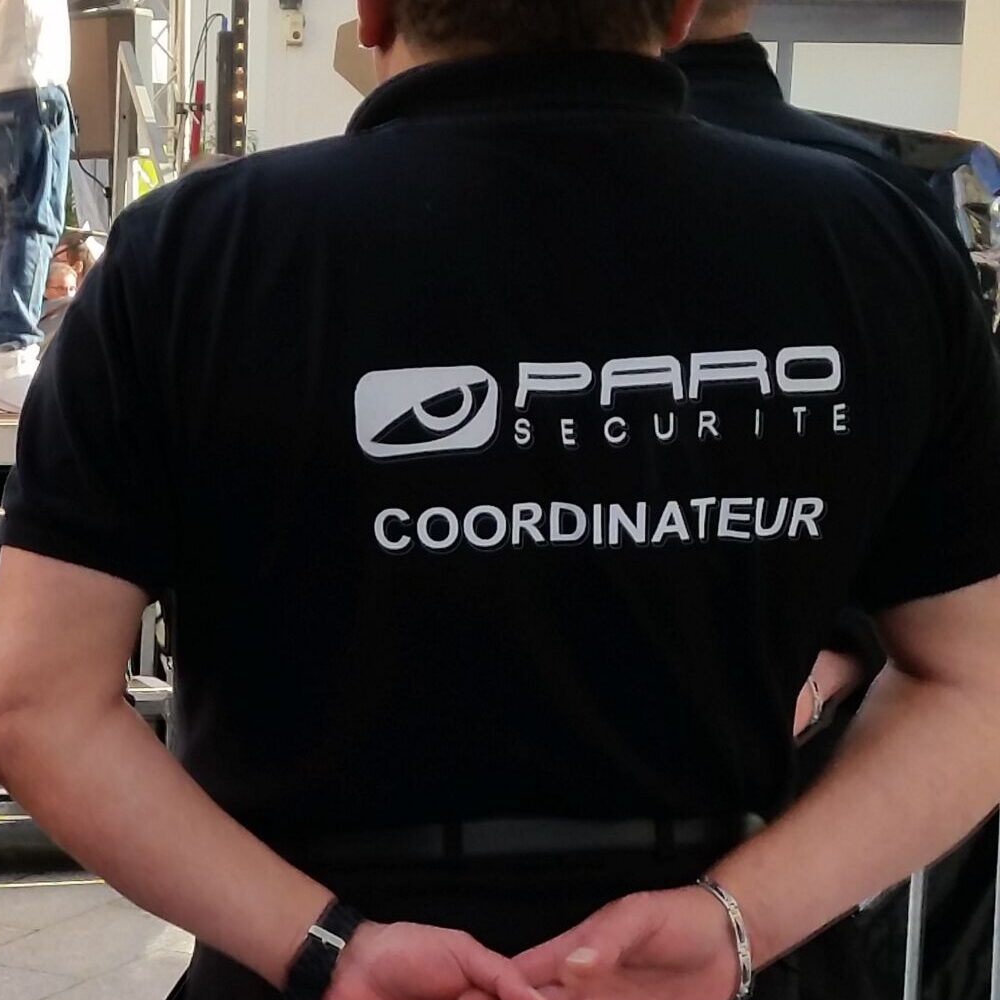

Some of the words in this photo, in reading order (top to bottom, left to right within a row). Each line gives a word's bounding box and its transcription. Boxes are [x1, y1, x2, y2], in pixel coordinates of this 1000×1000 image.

[514, 345, 842, 407] PARO
[514, 402, 848, 446] SECURITE
[374, 496, 824, 550] COORDINATEUR
